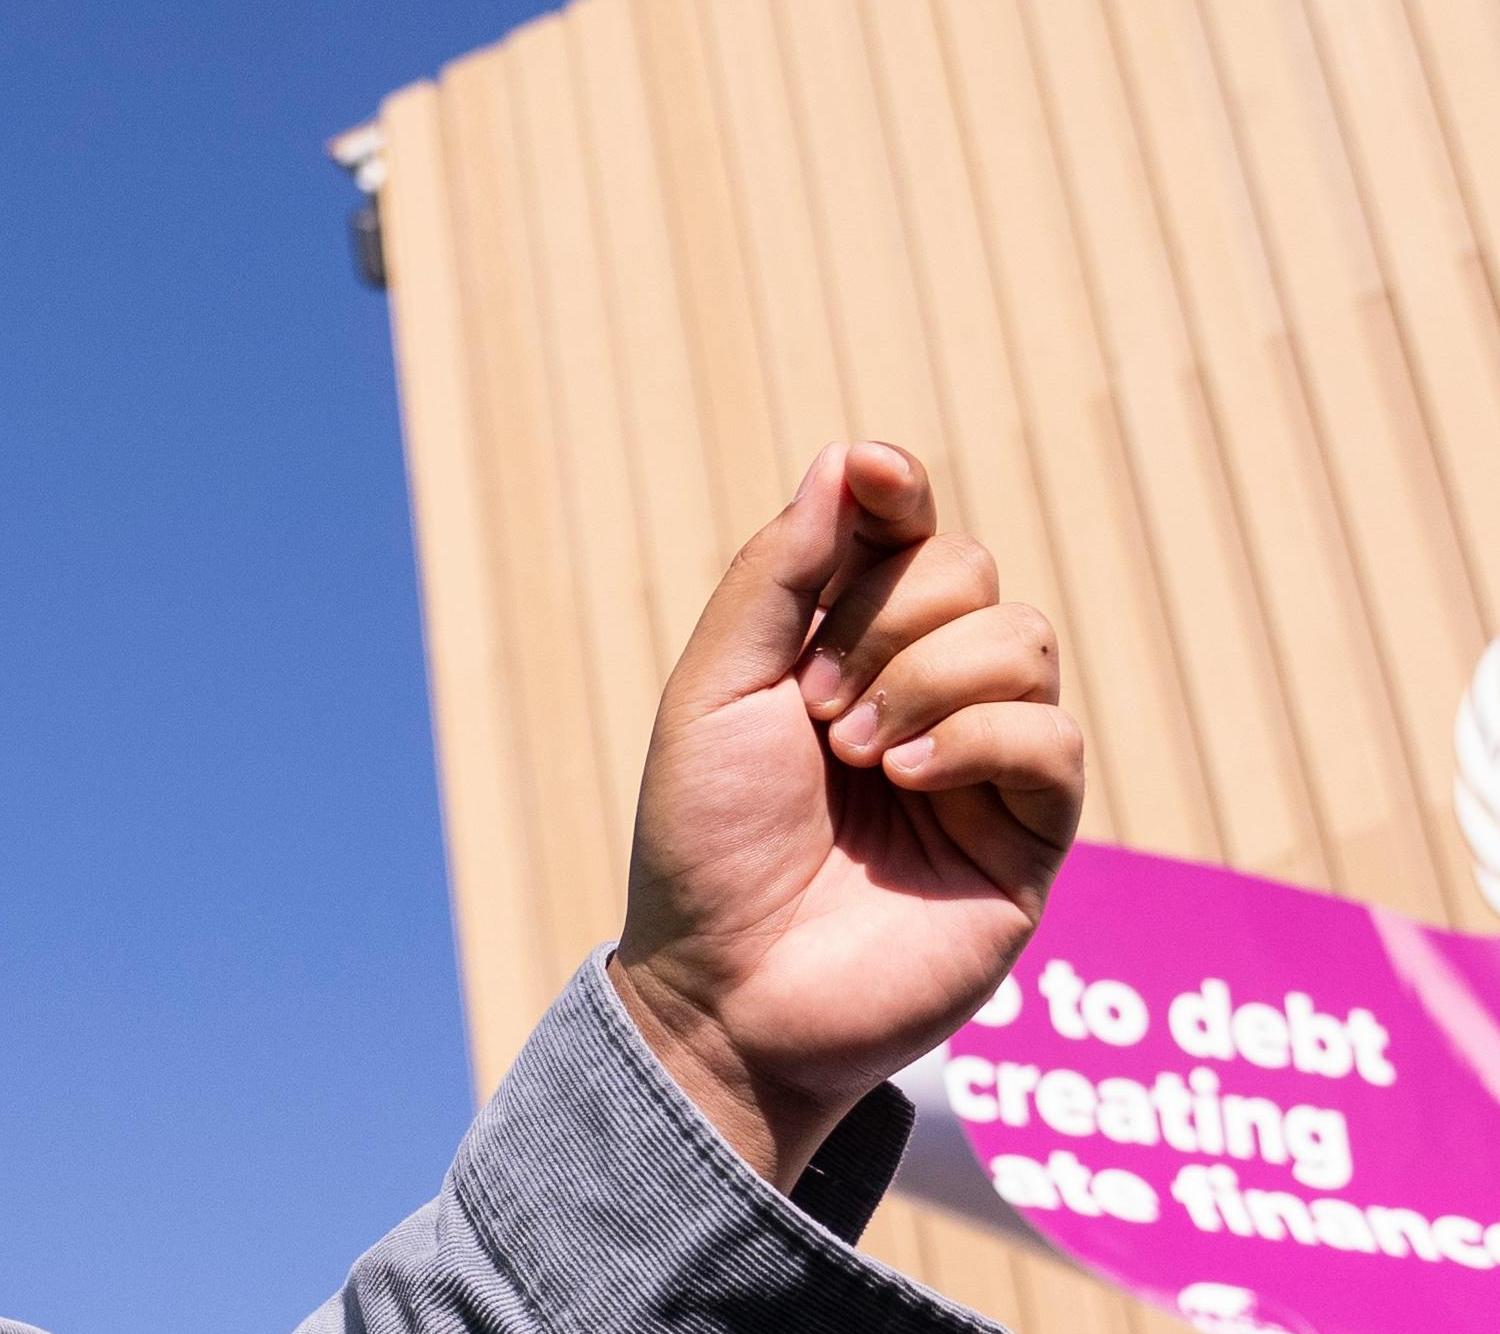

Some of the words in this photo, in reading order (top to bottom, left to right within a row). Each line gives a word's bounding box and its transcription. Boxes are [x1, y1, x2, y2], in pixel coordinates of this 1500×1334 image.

[1039, 958, 1149, 1047] to
[1168, 978, 1397, 1087] debt
[943, 1054, 1354, 1190] creating
